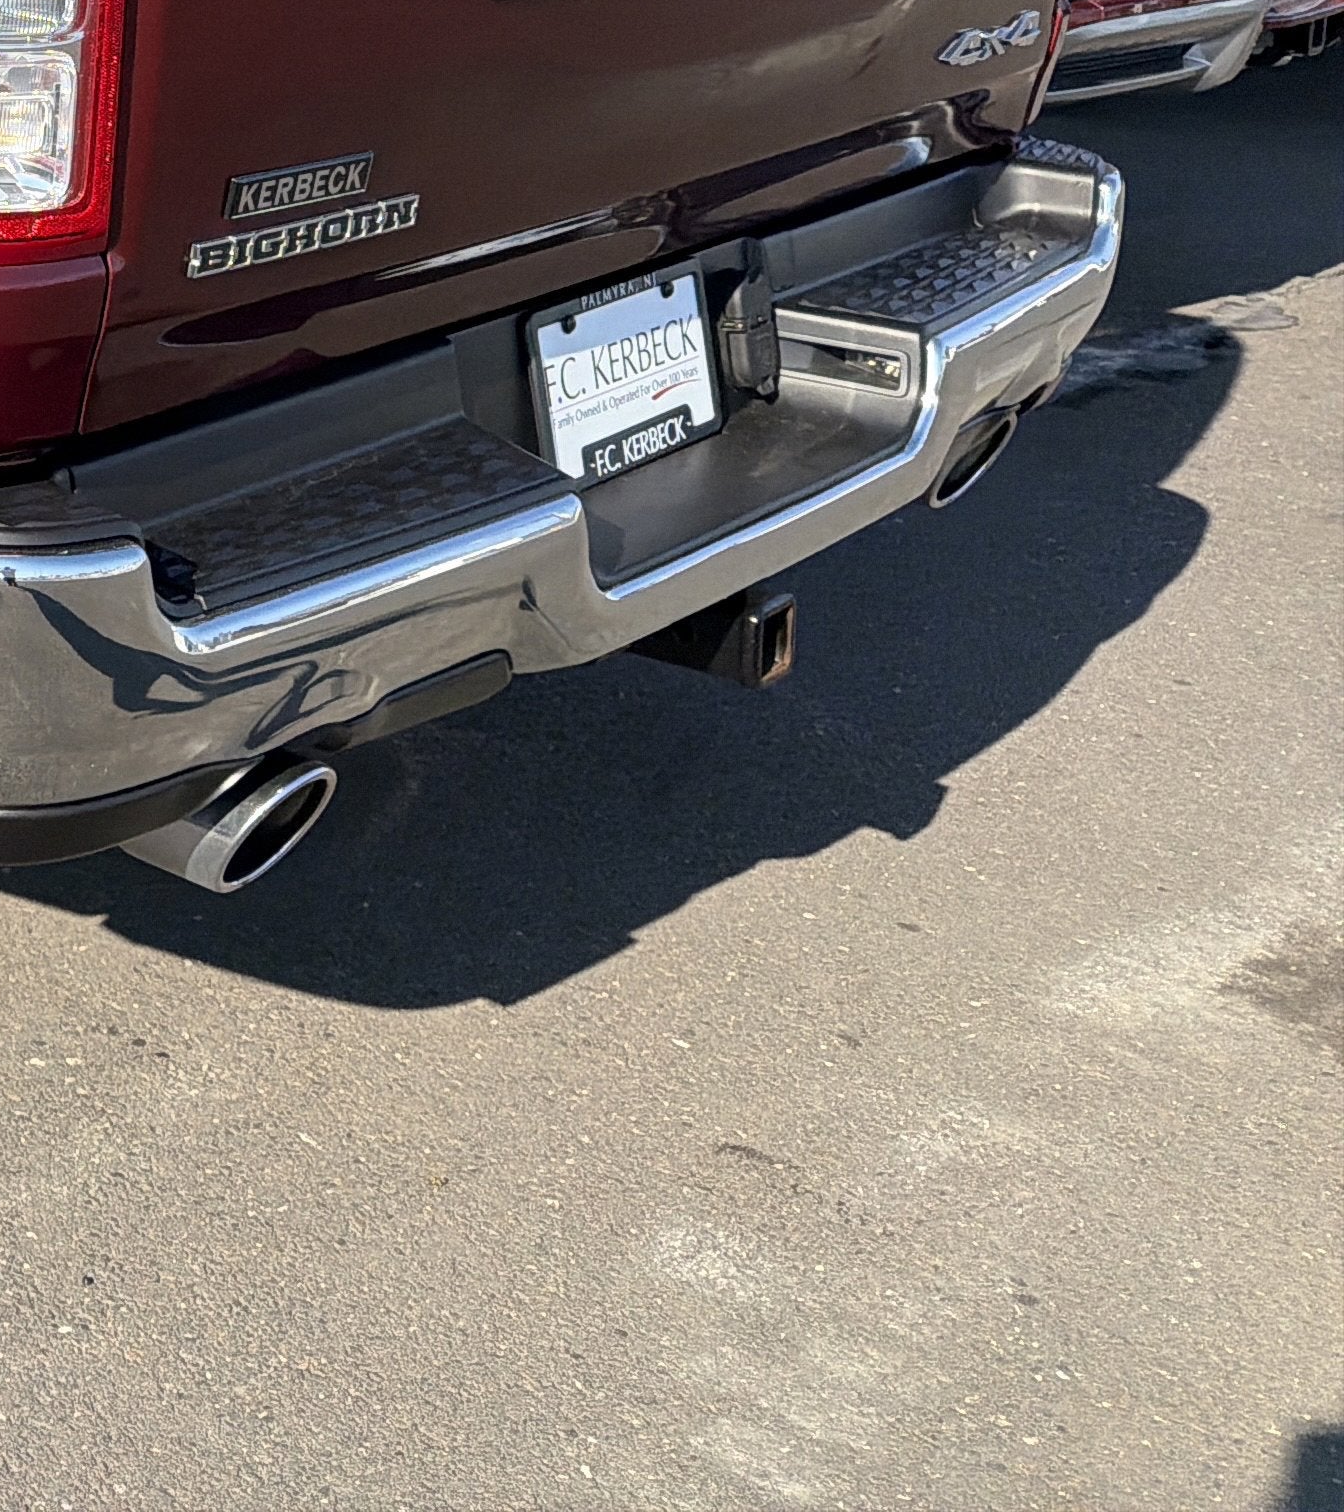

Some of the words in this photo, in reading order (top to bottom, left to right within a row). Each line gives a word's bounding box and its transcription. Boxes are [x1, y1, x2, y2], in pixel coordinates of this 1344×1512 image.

[237, 161, 368, 214] KERBECK
[187, 193, 420, 278] BIGHORN
[642, 272, 657, 289] NJ
[591, 313, 698, 390] KERBECK
[552, 414, 575, 432] Family
[575, 402, 601, 421] Owned
[602, 400, 609, 412] &
[608, 387, 640, 409] Operated
[640, 384, 651, 397] For
[652, 376, 668, 391] Over
[668, 370, 681, 384] 100
[682, 366, 698, 380] Years
[595, 444, 622, 478] F.C.
[621, 414, 687, 465] KERBECK
